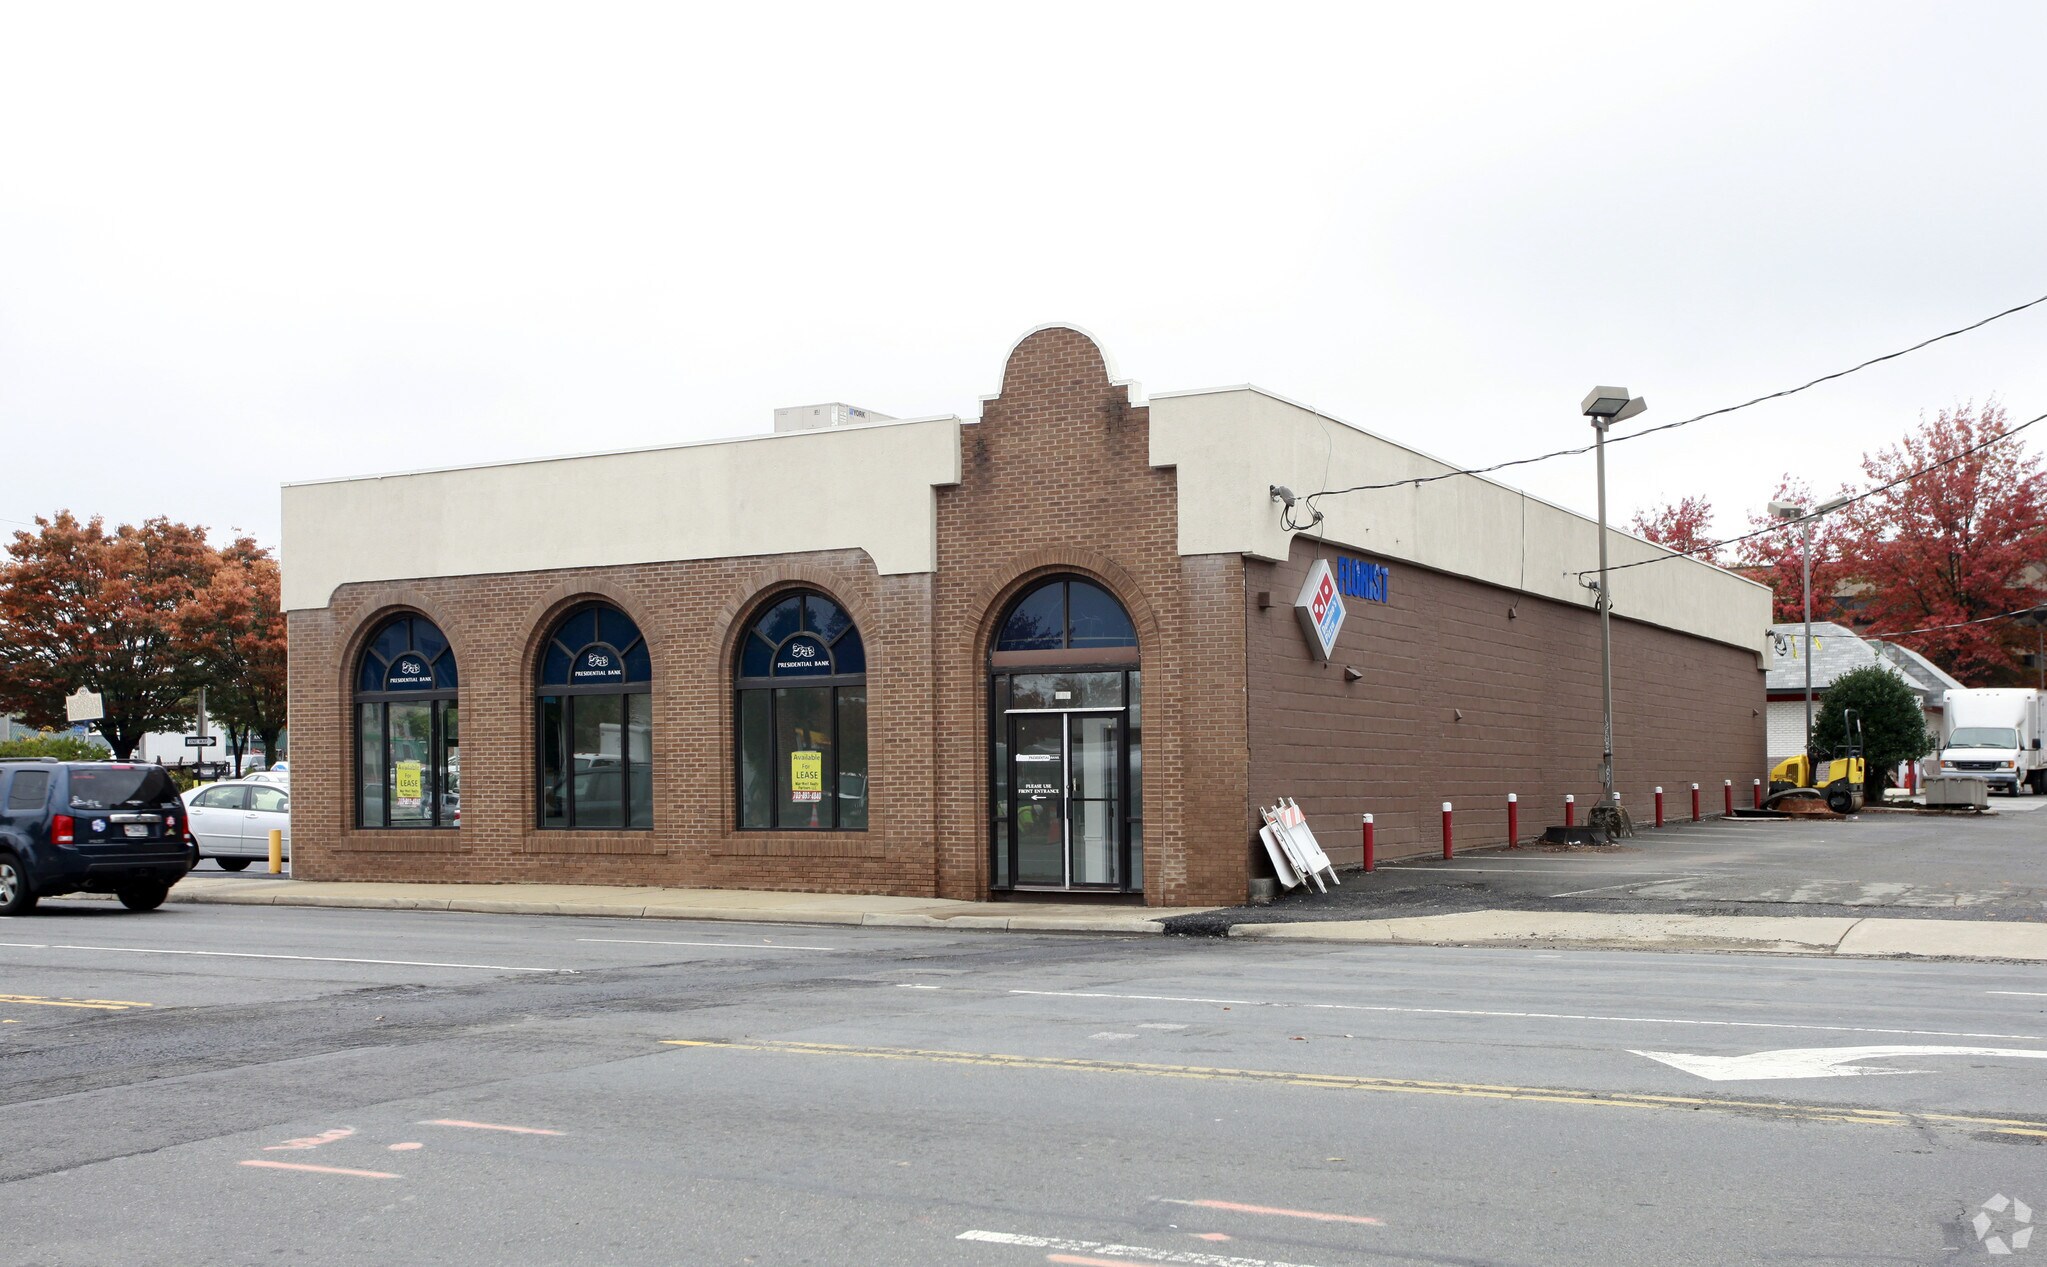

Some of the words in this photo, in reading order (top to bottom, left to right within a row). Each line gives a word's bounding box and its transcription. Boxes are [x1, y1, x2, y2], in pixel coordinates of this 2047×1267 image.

[1337, 556, 1389, 603] FLORIST
[1321, 600, 1337, 635] Domino's
[400, 779, 418, 787] LEASE
[796, 771, 818, 779] LEASE
